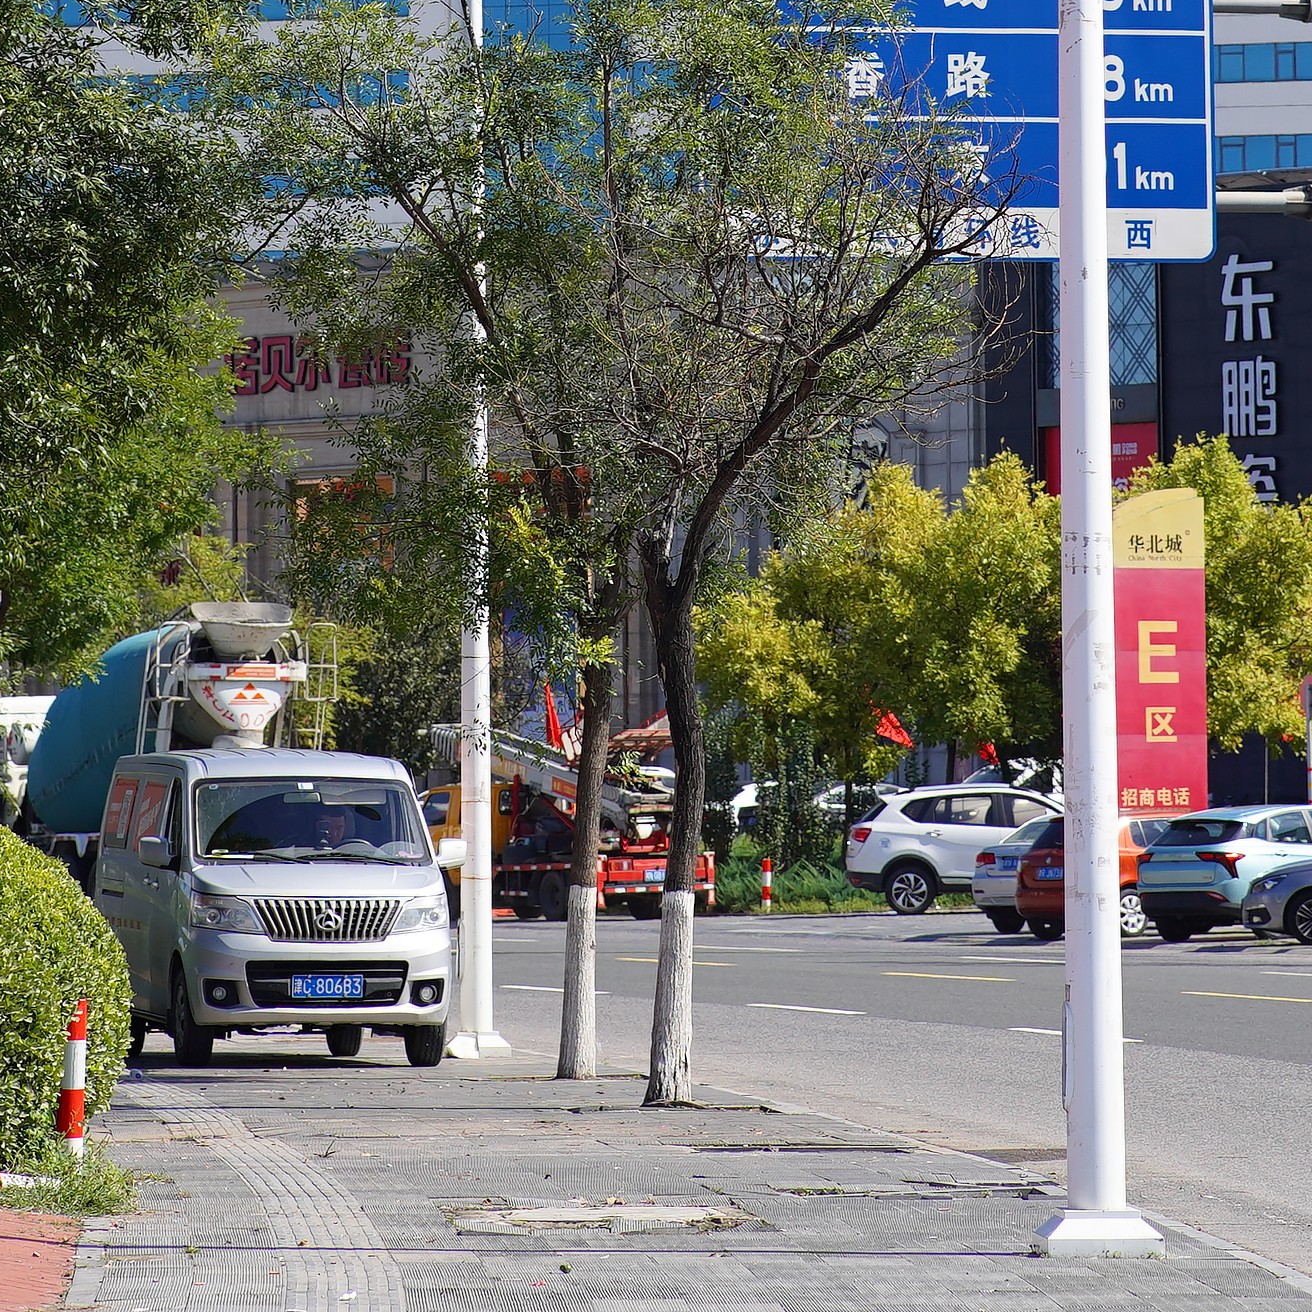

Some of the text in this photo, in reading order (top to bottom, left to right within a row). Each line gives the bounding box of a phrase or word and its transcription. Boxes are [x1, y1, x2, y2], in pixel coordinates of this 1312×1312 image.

[1134, 78, 1174, 102] km
[1135, 165, 1175, 191] km
[1124, 218, 1154, 250] 西
[1127, 533, 1183, 553] 华北城
[1120, 787, 1192, 807] 招商电话
